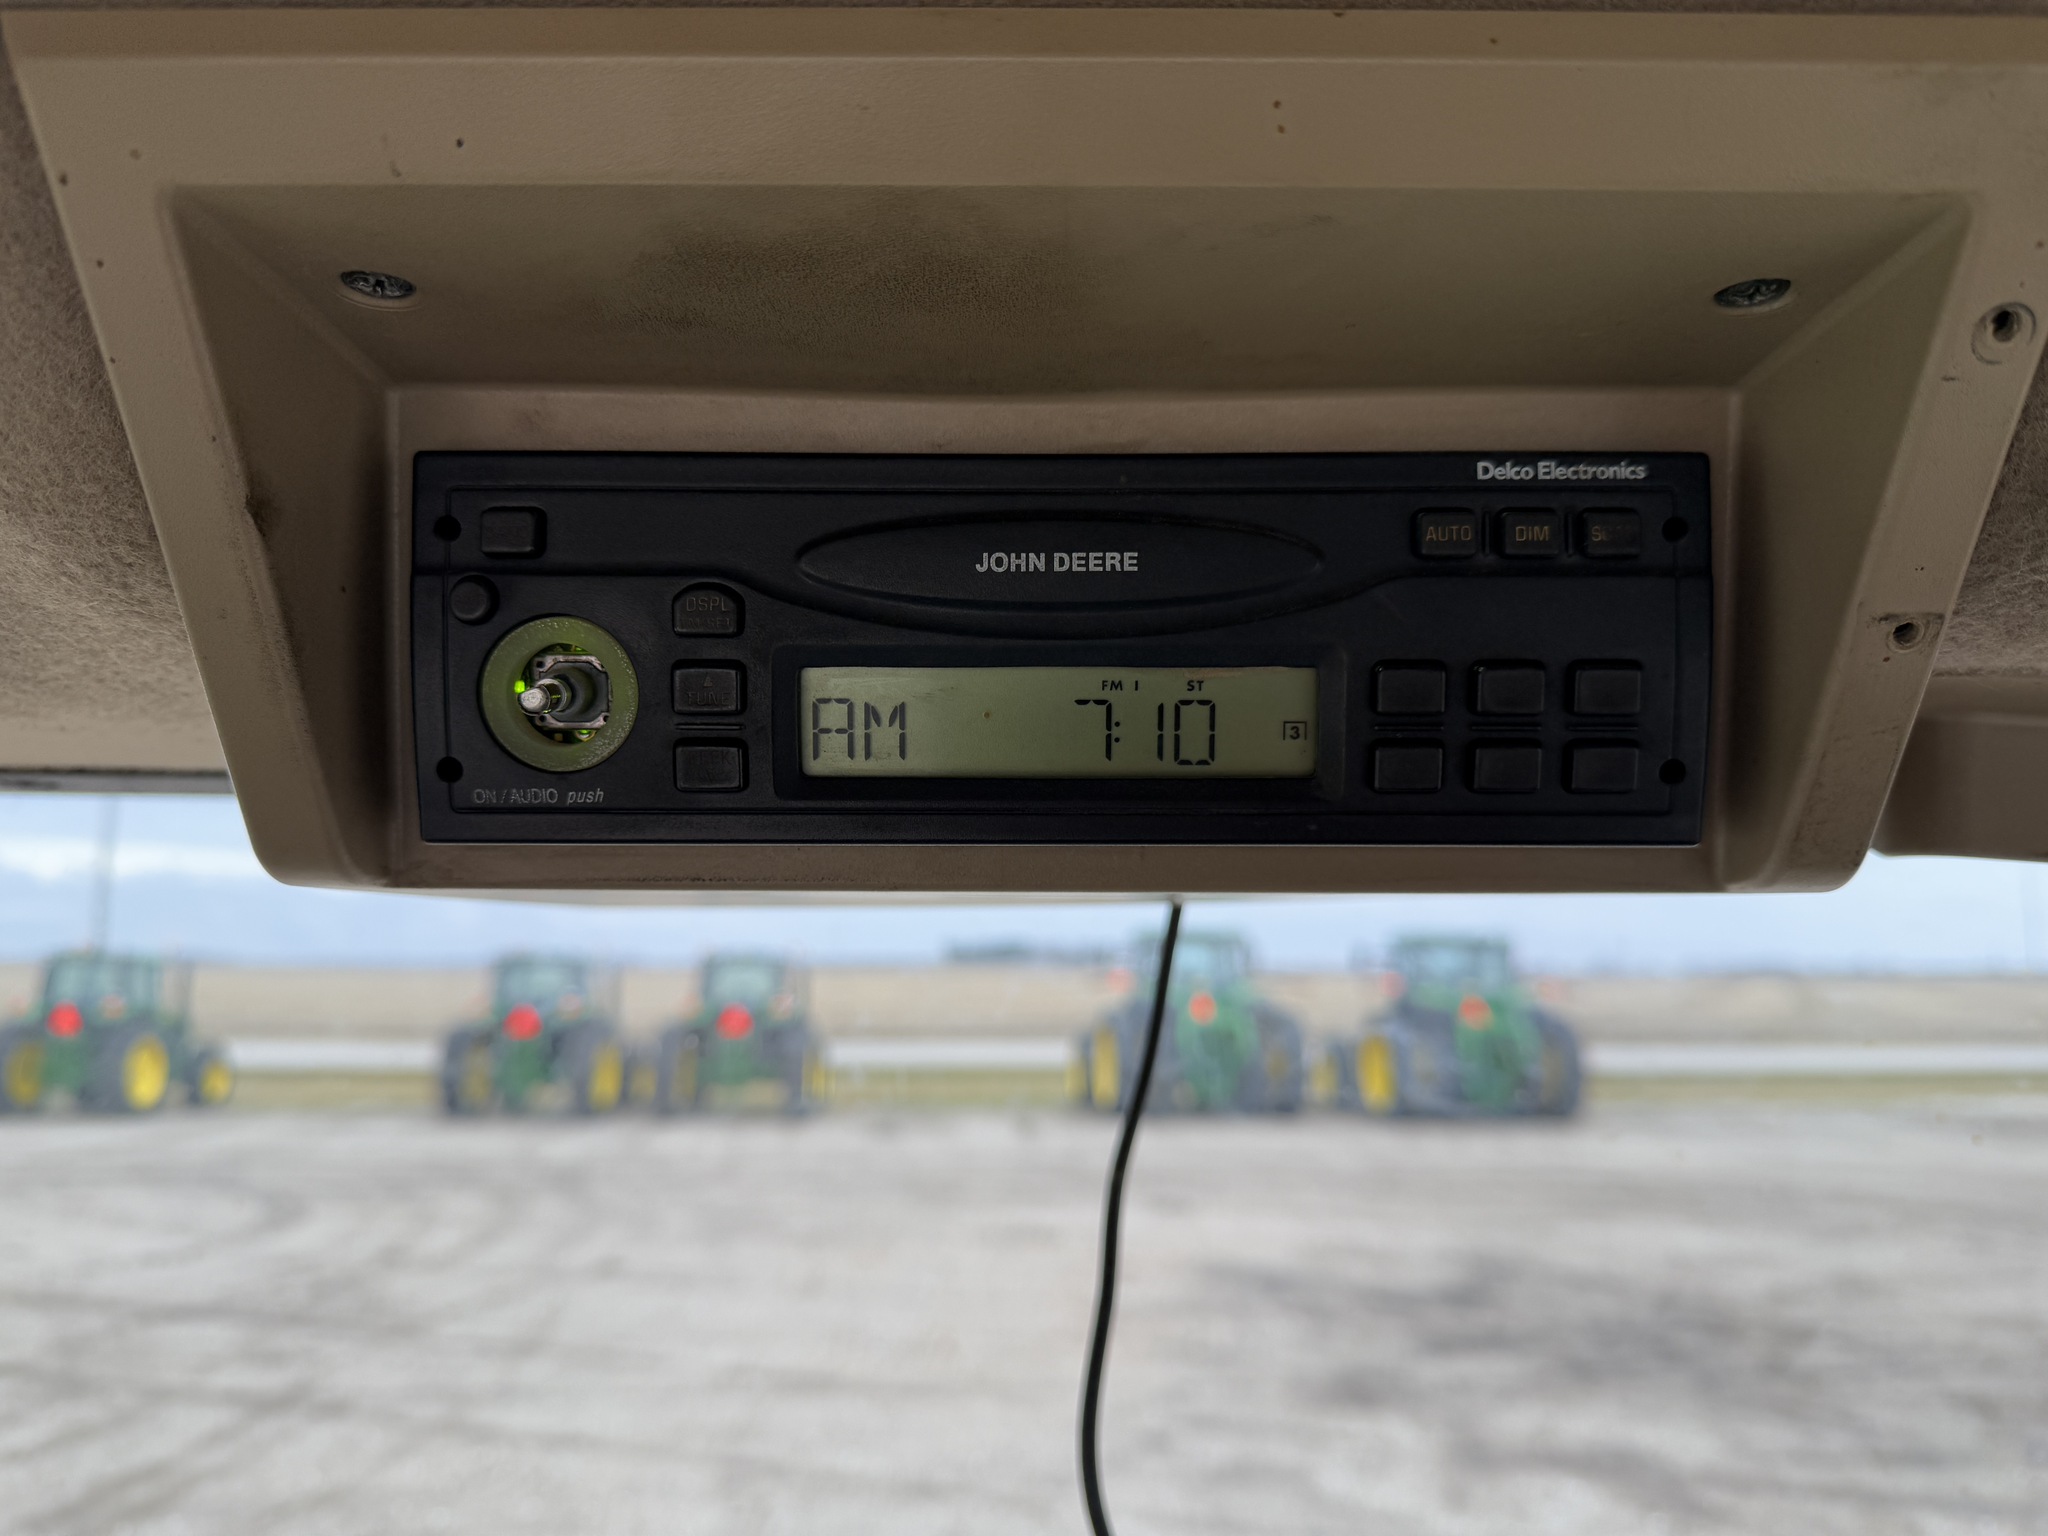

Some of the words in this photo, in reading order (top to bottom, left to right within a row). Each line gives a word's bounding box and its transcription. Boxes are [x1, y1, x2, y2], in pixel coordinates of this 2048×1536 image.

[1476, 460, 1535, 481] Delco
[1537, 459, 1648, 481] Electronics
[1425, 525, 1473, 542] AUTO
[1515, 525, 1550, 542] DIM
[975, 551, 1046, 573] JOHN
[1053, 551, 1139, 573] DEERE
[685, 596, 731, 613] DSPL
[1101, 680, 1123, 692] FM
[1186, 680, 1205, 692] ST
[686, 691, 730, 707] TUNE
[812, 698, 907, 761] AM
[1074, 699, 1216, 766] 7:10
[1289, 726, 1301, 740] 3
[566, 788, 605, 807] push
